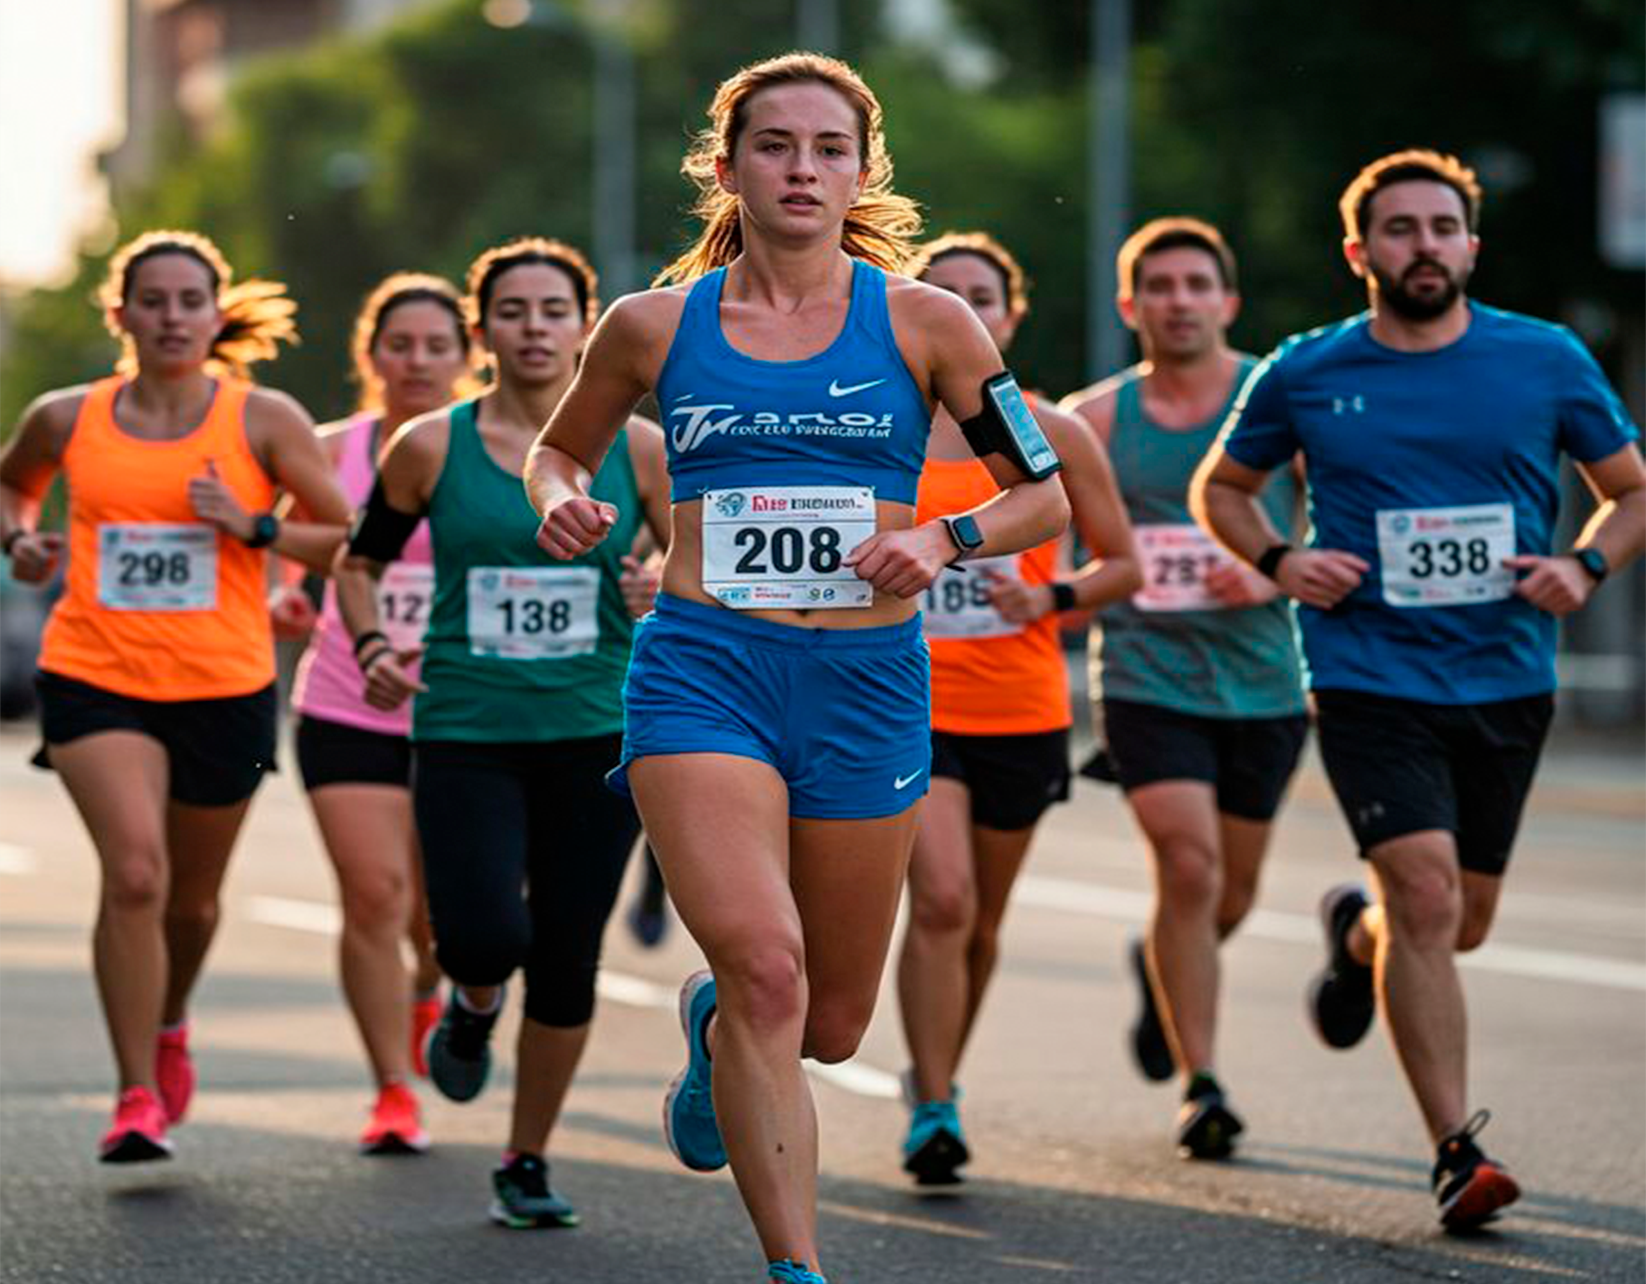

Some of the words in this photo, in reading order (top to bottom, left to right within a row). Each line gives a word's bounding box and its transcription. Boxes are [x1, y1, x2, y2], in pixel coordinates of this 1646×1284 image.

[117, 550, 190, 587] 298
[734, 525, 842, 574] 208
[1408, 536, 1489, 578] 338
[496, 598, 572, 635] 138
